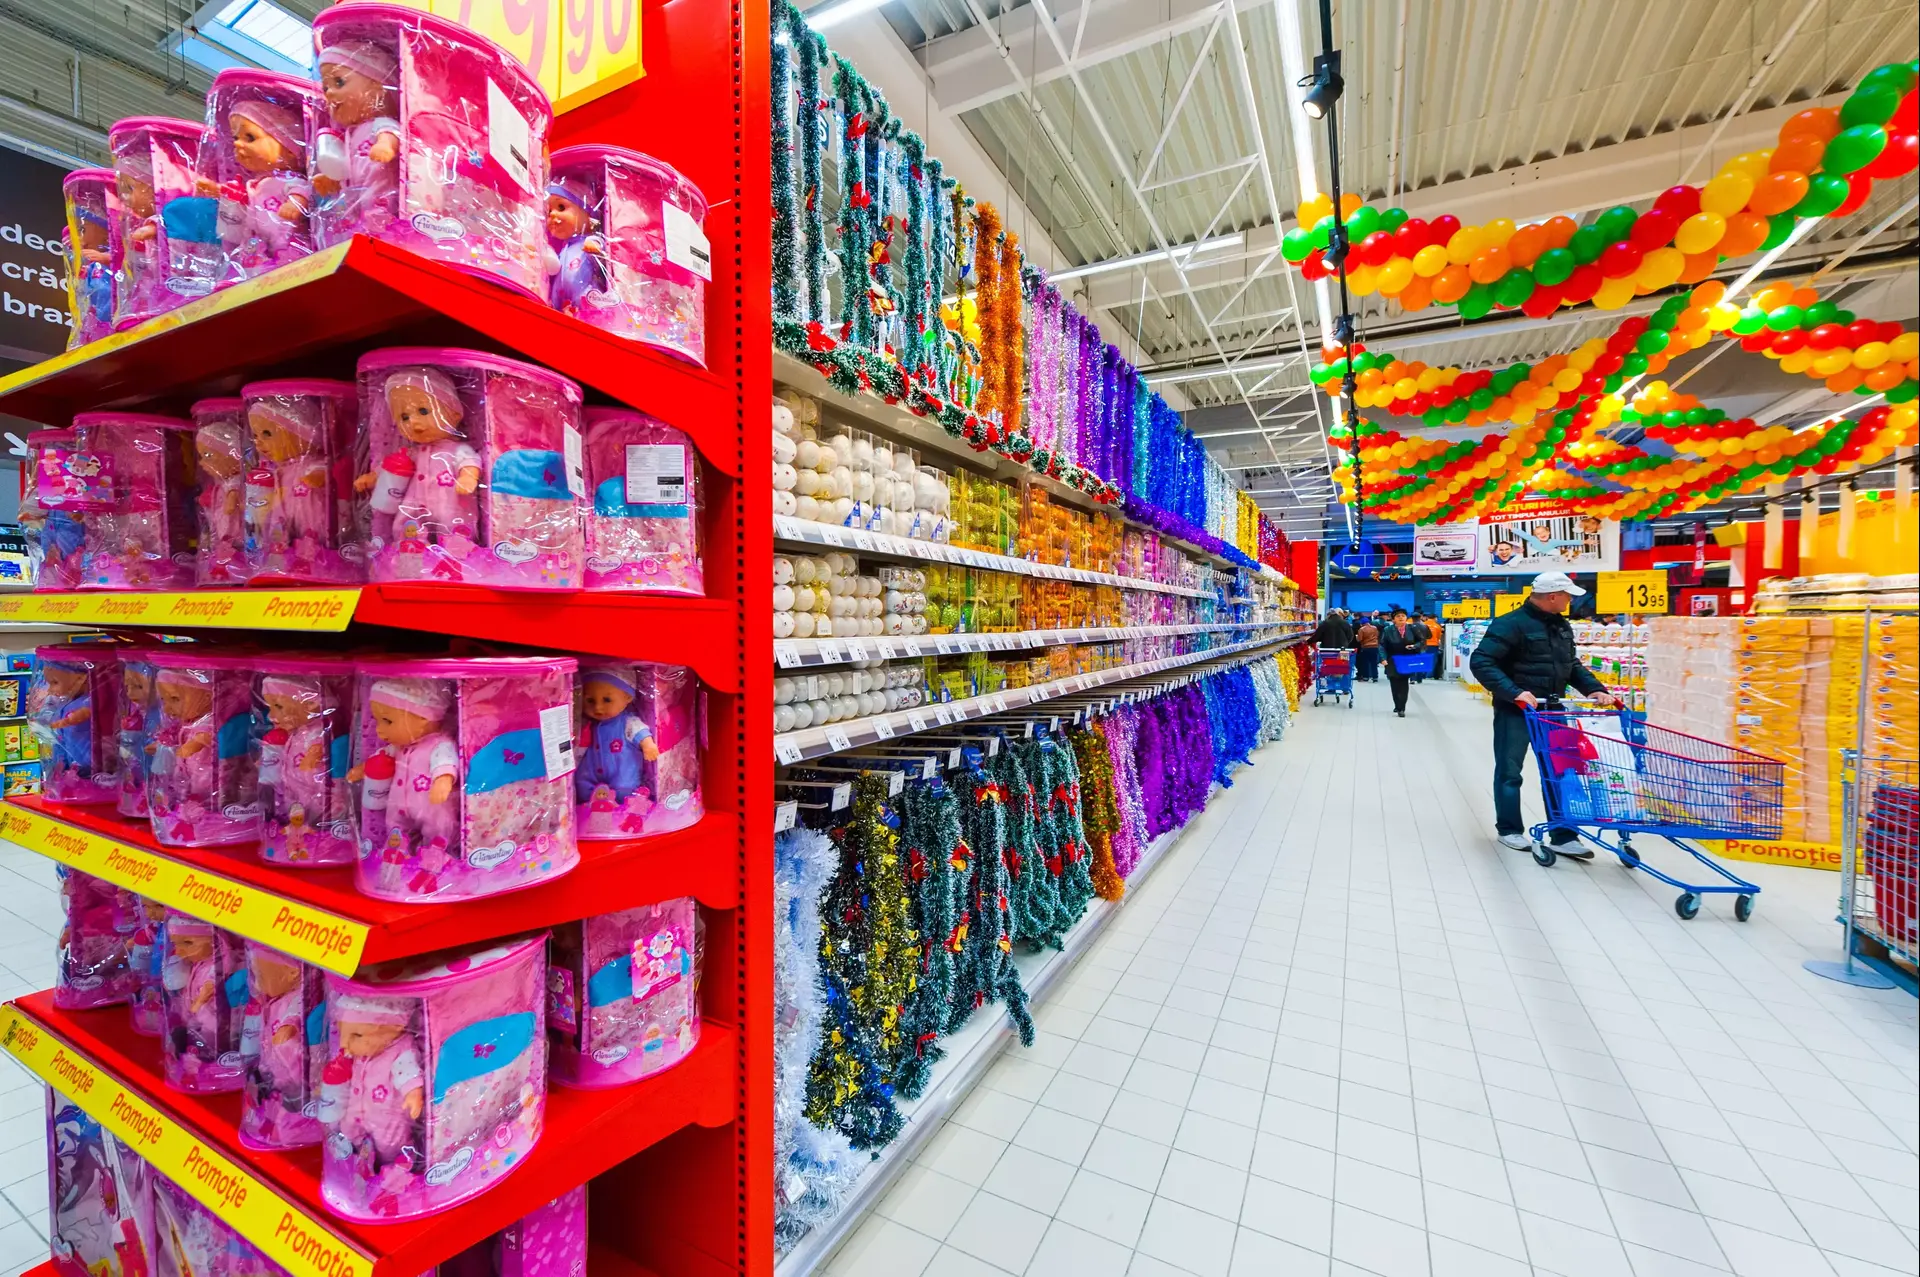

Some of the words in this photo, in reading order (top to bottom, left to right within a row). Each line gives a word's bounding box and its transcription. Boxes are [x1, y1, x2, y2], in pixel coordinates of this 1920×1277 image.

[1490, 513, 1506, 521] TOT
[1540, 500, 1564, 508] MIC
[1627, 584, 1649, 608] 13
[1650, 594, 1665, 607] 95
[98, 597, 150, 621] Promoție
[168, 596, 235, 622] Promoție
[262, 595, 344, 626] Promoție
[1473, 604, 1483, 616] 71
[1724, 838, 1843, 866] Promoție
[44, 826, 89, 860] Promoție
[104, 848, 158, 885] Promoție
[179, 873, 243, 918] Promoție
[272, 906, 353, 960] Promoție
[49, 1049, 95, 1095] Promoție
[110, 1092, 163, 1145] Promoție
[183, 1145, 248, 1209] Promoție
[275, 1211, 354, 1277] Promoție
